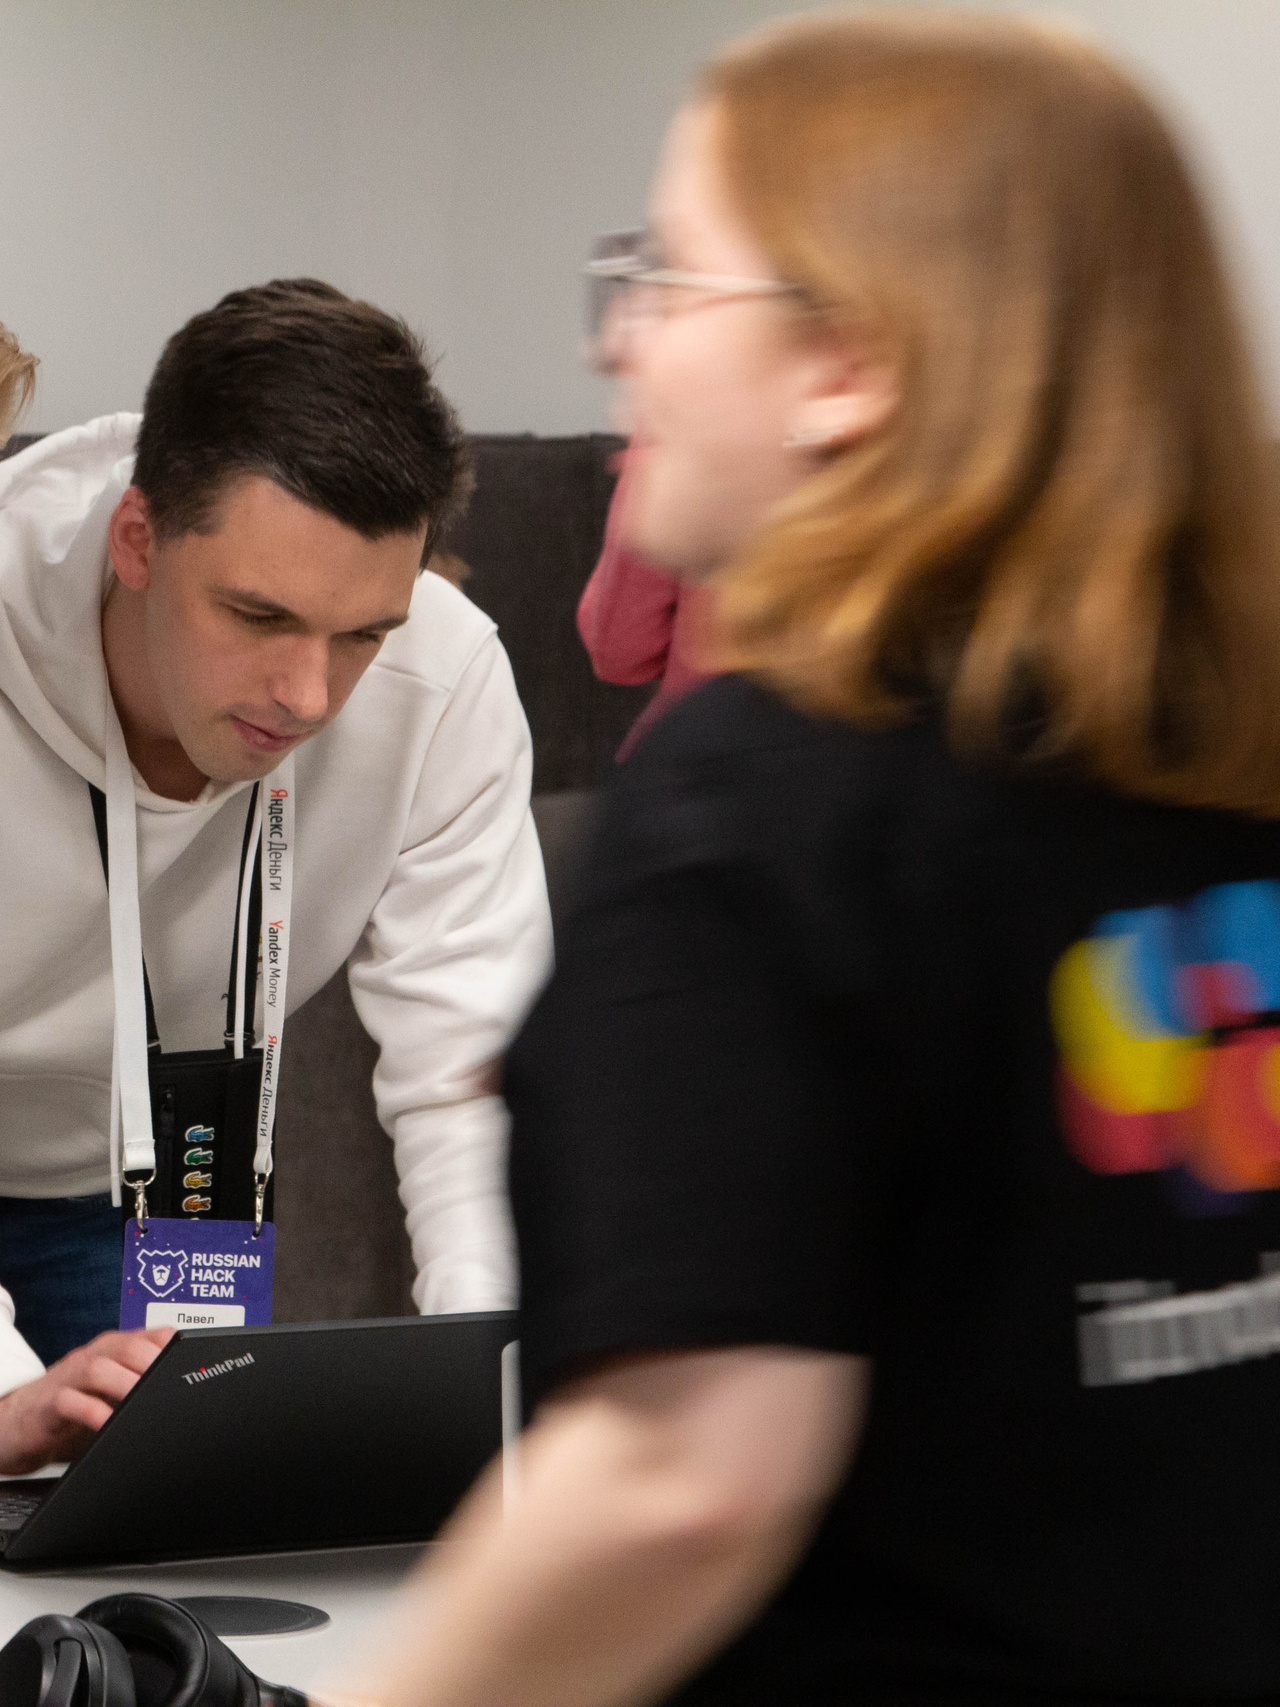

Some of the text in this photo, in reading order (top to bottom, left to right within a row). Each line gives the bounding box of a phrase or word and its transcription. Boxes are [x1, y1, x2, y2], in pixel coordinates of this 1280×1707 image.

[267, 788, 289, 891] Яндекс Деньги
[267, 920, 284, 1008] Yandex Money
[260, 1034, 278, 1137] Яндекс Деньги
[191, 1252, 261, 1268] RUSSIAN
[190, 1268, 236, 1283] HACK
[190, 1283, 235, 1298] TEAM
[177, 1312, 215, 1324] Павел
[181, 1352, 256, 1386] ThinkPad
